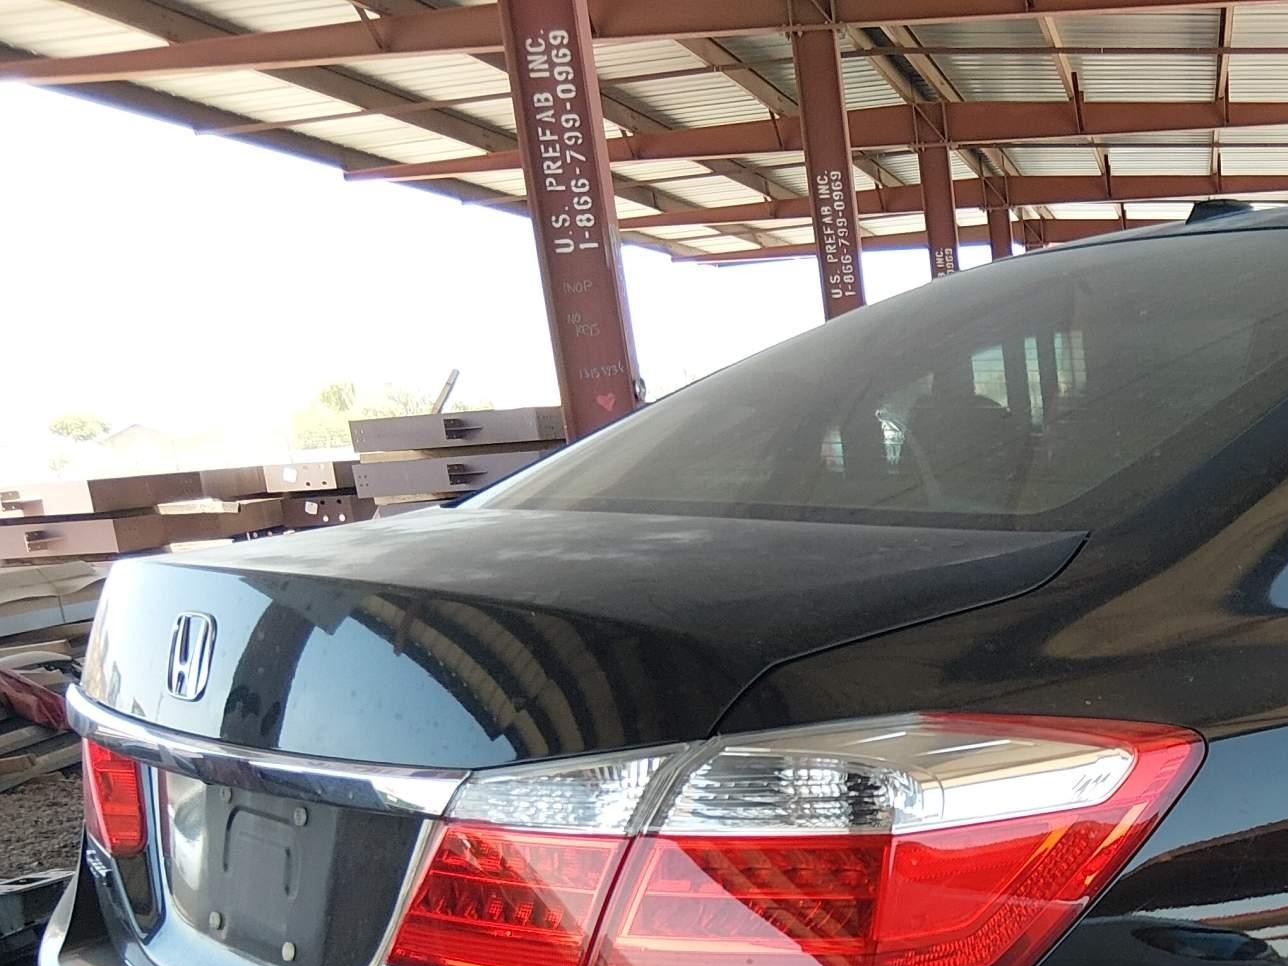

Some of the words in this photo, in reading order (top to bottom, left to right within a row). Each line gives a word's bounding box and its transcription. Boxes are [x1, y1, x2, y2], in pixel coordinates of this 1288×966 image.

[525, 29, 550, 78] INC.
[533, 92, 566, 191] PREFAB
[548, 29, 599, 249] 1-866-799-0969
[817, 170, 831, 199] INC.
[551, 206, 575, 253] U.S.
[820, 205, 839, 263] PREFAB
[830, 171, 857, 296] 1-866-799-0969
[829, 270, 843, 299] U.S.
